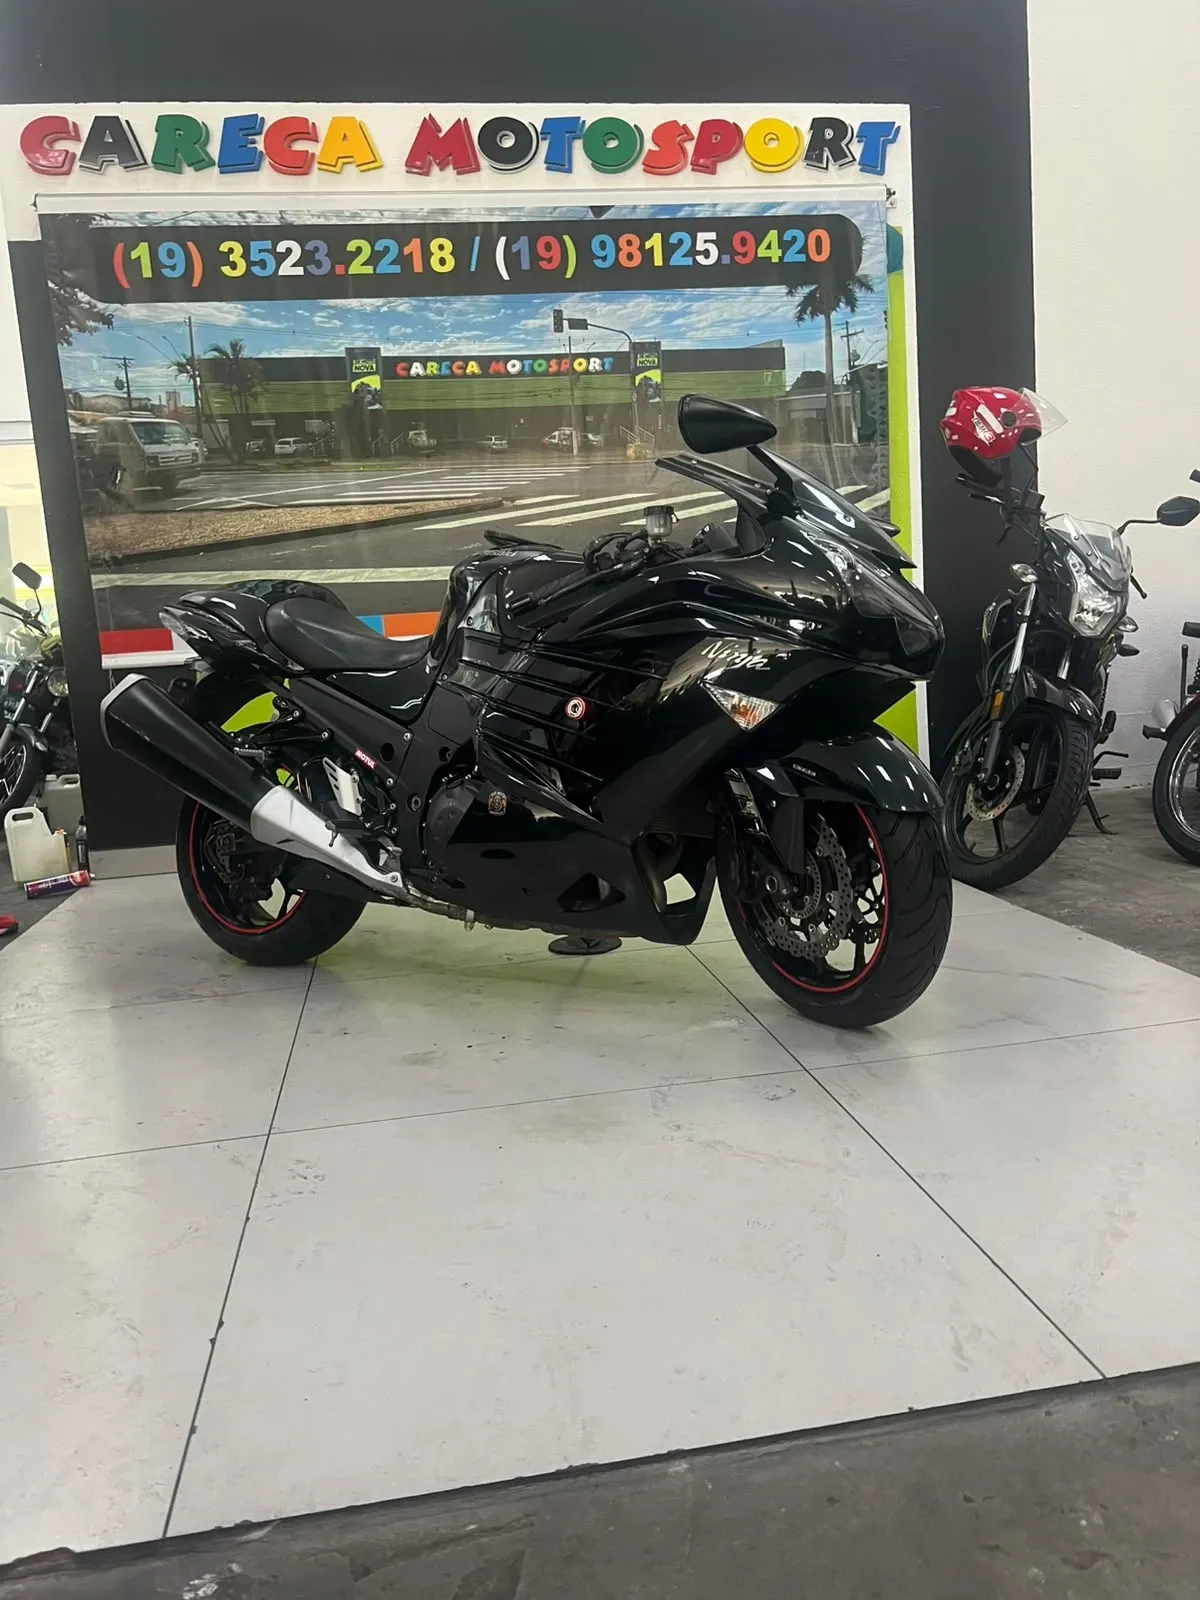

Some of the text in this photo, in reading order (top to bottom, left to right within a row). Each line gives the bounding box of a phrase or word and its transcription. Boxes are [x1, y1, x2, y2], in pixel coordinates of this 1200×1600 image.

[20, 113, 900, 177] CARECA MOTOSPORT
[113, 240, 204, 289] (19)
[218, 238, 456, 278] 3523.2218
[495, 234, 577, 281] (19)
[590, 228, 831, 270] 98125.9420
[395, 357, 614, 378] CARECA MOTOSPORT
[701, 640, 771, 671] Ninja
[355, 750, 375, 769] MOTUL
